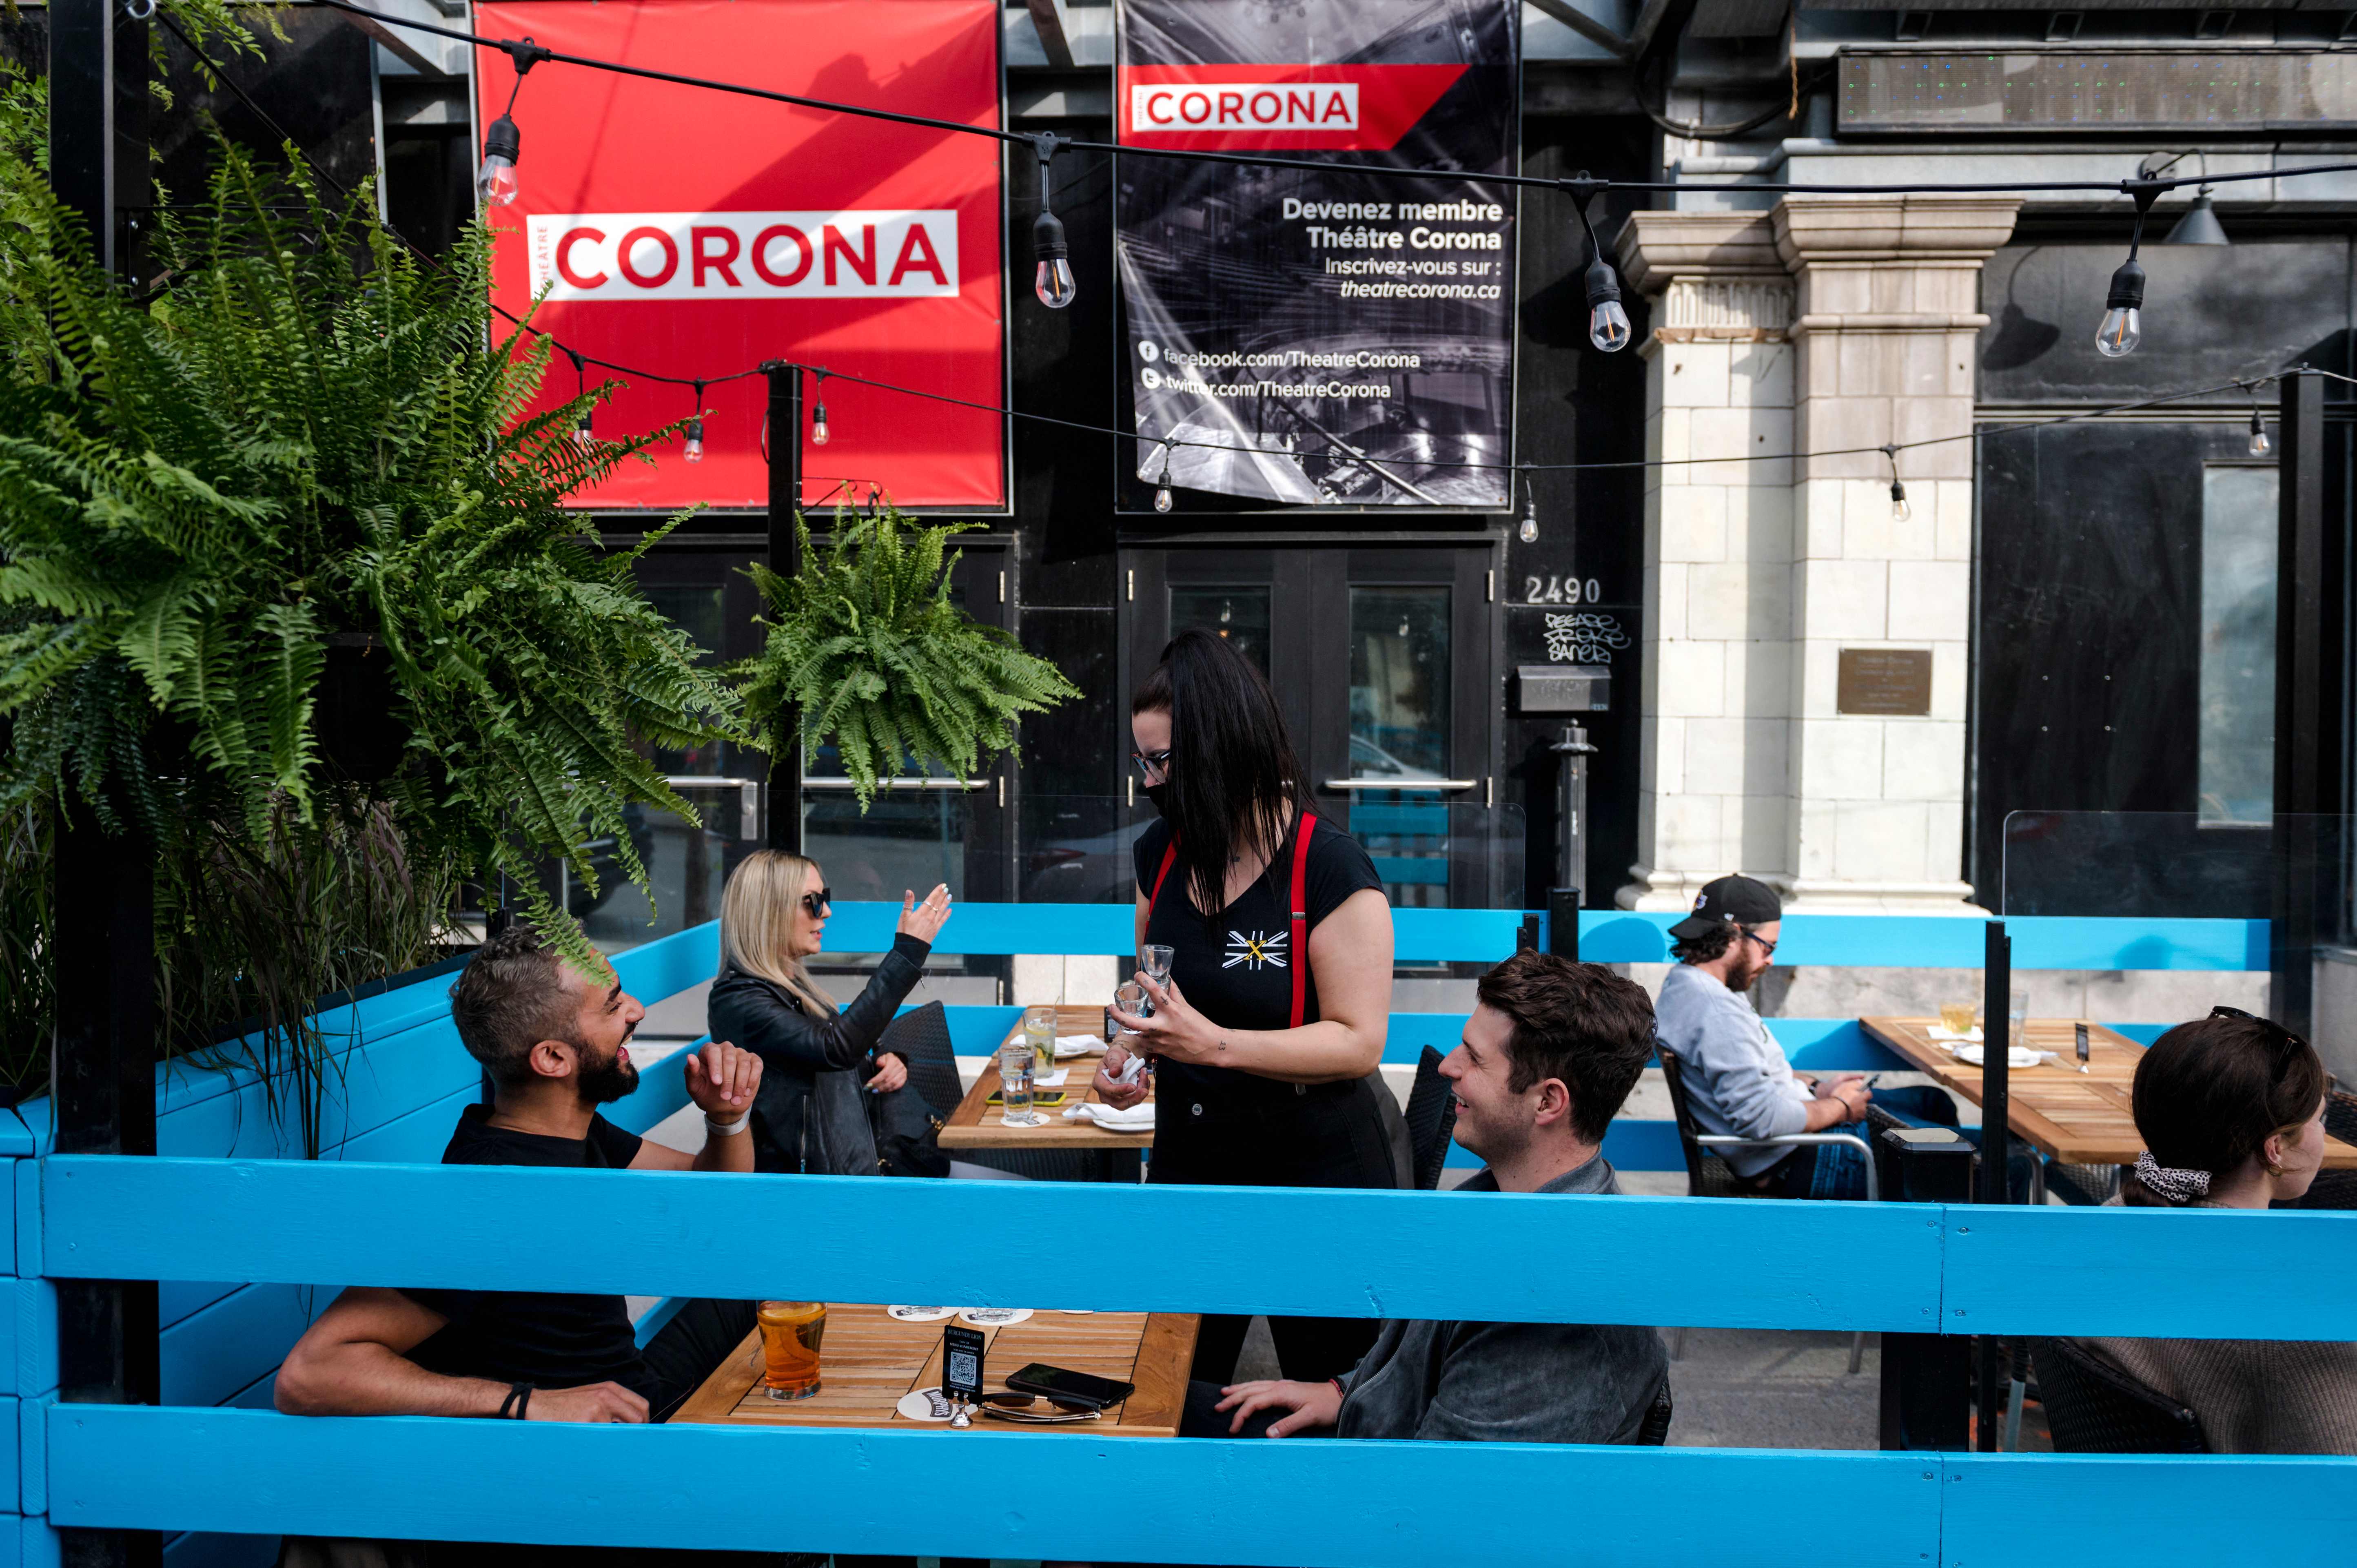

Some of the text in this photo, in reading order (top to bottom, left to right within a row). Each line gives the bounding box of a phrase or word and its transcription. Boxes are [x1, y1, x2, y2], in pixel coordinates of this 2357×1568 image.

[1147, 91, 1351, 124] CORONA
[1283, 198, 1503, 221] Devenez membre
[1306, 226, 1501, 249] Théâtre Corona
[557, 224, 949, 289] CORONA
[1326, 257, 1457, 276] Inscrivez-vous
[1461, 261, 1492, 276] sur
[1340, 280, 1501, 299] theatrecorona.ca
[1164, 348, 1420, 369] facebook.com/TheatreCorona
[1165, 374, 1391, 399] twitter.com/TheatreCorona
[1526, 576, 1600, 604] 2490
[948, 1329, 971, 1338] BURGUNDY
[927, 1391, 950, 1416] MURPHY'S
